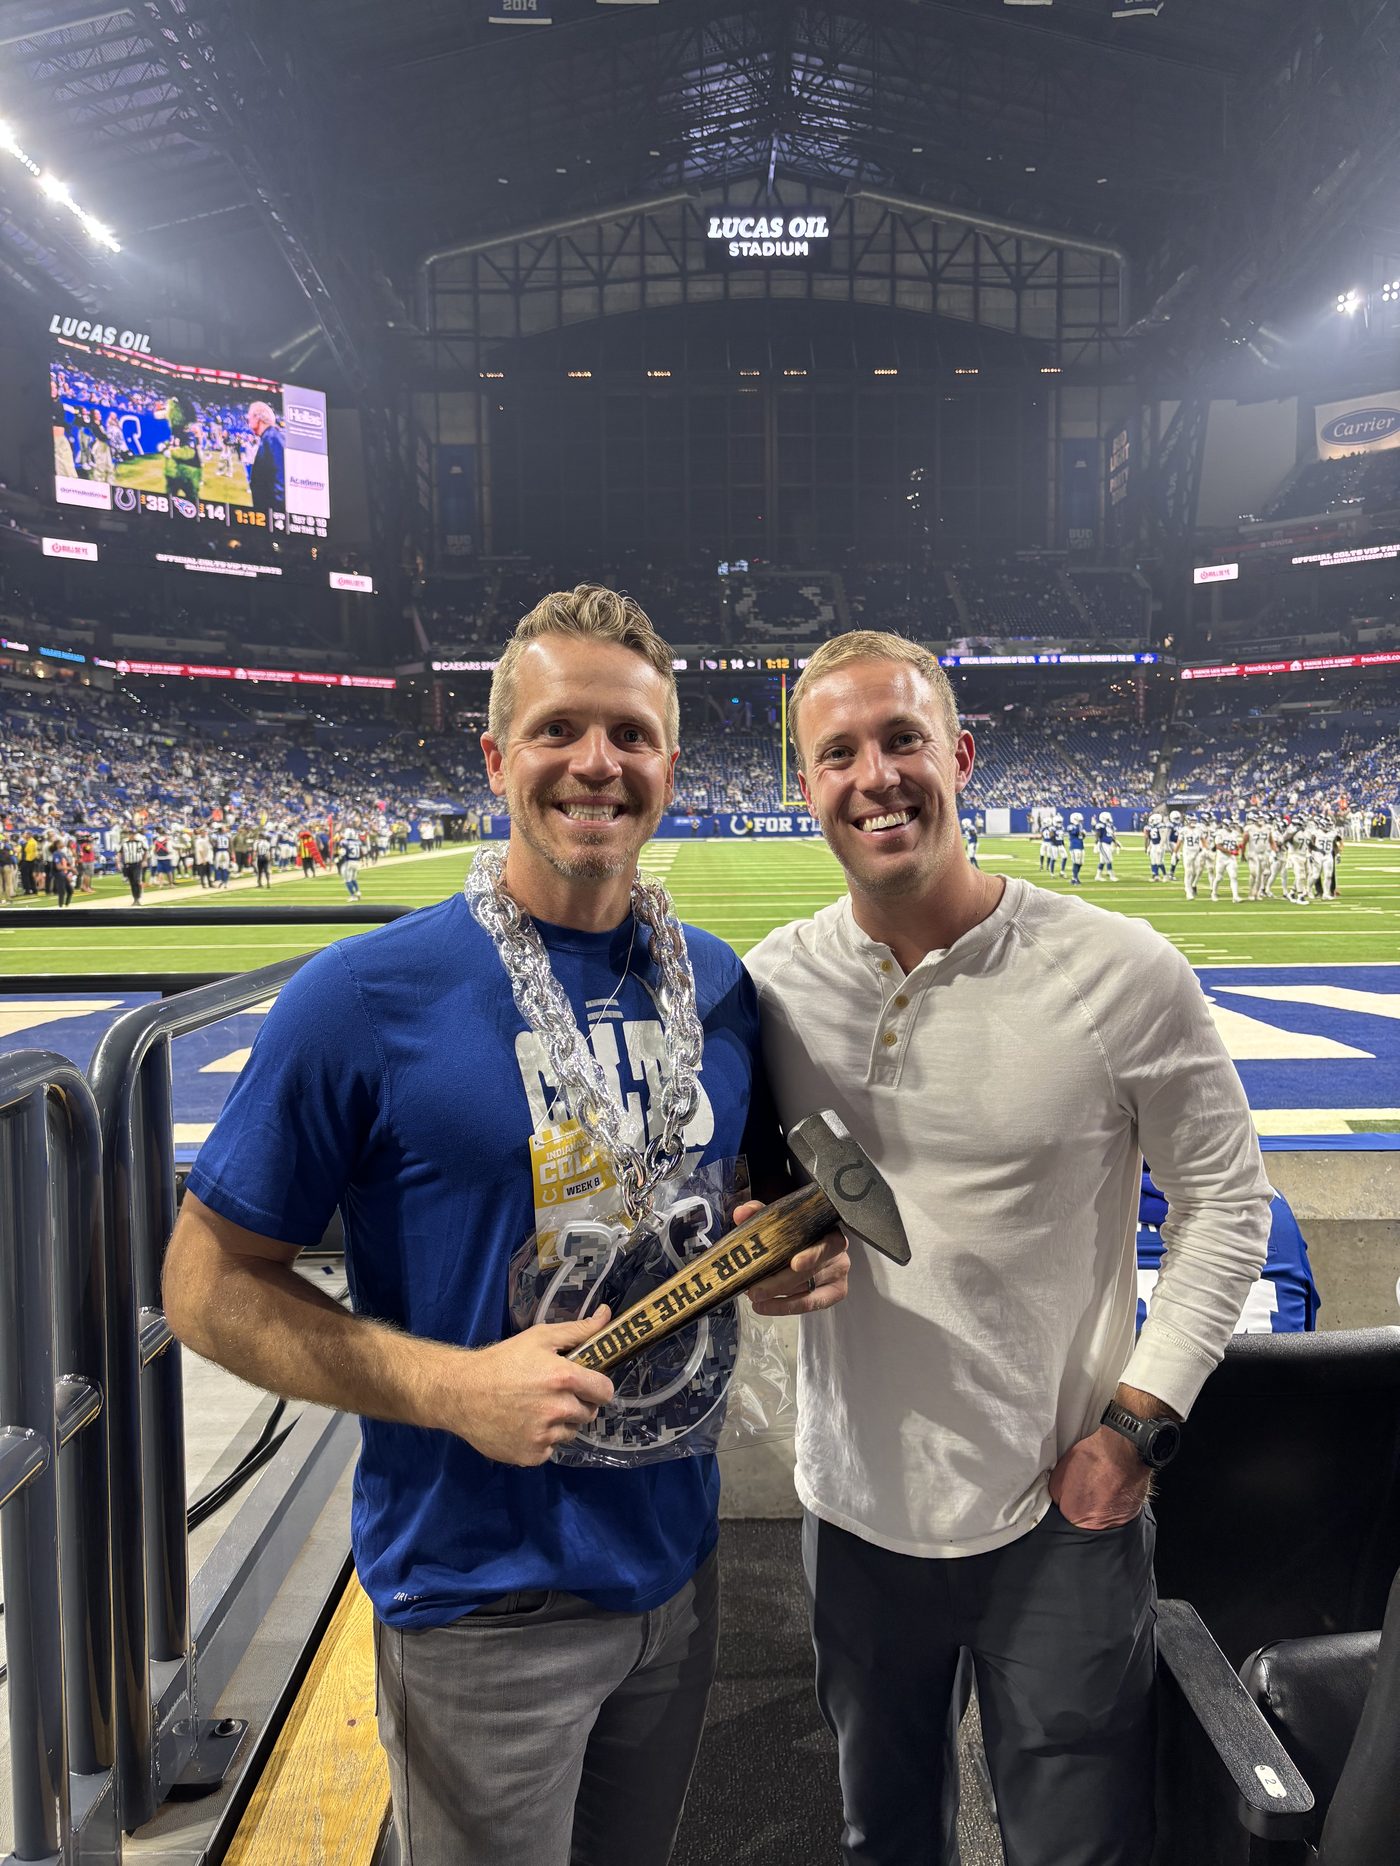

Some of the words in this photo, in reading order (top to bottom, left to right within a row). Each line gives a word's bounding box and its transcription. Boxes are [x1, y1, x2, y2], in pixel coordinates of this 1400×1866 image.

[707, 216, 784, 239] LUCAS
[788, 216, 830, 238] OIL
[728, 240, 809, 257] STADIUM
[49, 314, 118, 346] LUCAS
[119, 330, 152, 353] OIL
[1334, 416, 1395, 438] Carrier
[145, 496, 169, 513] 38
[206, 504, 226, 521] 14
[234, 509, 267, 528] 1:12
[1292, 553, 1332, 565] OFFICIAL
[1333, 549, 1363, 559] COLTS
[1363, 546, 1380, 555] VIP
[441, 661, 481, 671] CAESARS
[730, 658, 744, 670] 14
[766, 658, 790, 669] 1:12
[753, 817, 793, 832] FOR
[1186, 836, 1200, 847] 84
[1252, 832, 1268, 844] 77
[1318, 839, 1333, 851] 36
[539, 1149, 600, 1186] COLT
[566, 1180, 593, 1197] WEEK
[594, 1177, 600, 1187] 8
[711, 1233, 769, 1281] FOR
[654, 1273, 714, 1322] THE
[578, 1310, 654, 1369] SHOE
